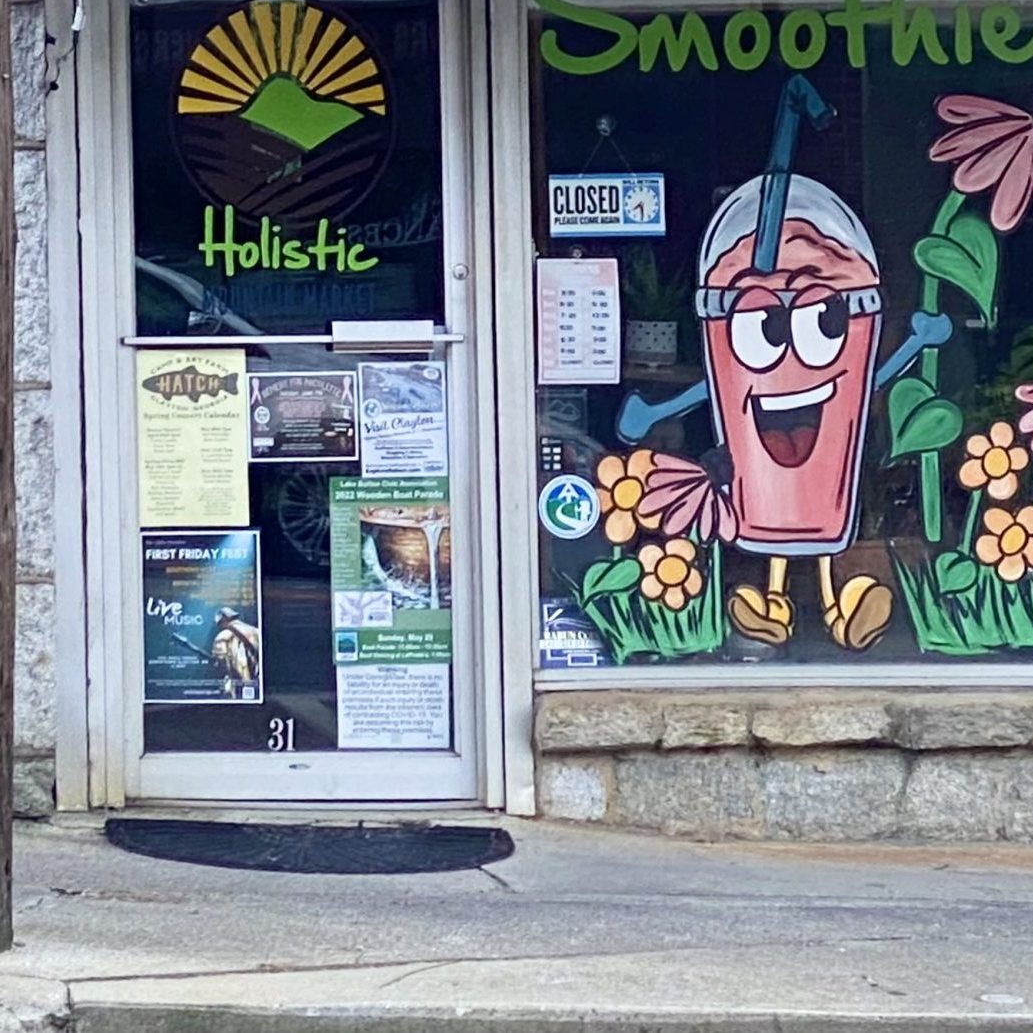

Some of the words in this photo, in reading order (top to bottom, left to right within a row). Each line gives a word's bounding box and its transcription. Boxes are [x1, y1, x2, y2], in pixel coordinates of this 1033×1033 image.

[553, 185, 619, 215] CLOSED
[554, 217, 578, 225] PLEASE
[580, 217, 599, 225] COME
[601, 216, 620, 224] AGAIN
[198, 204, 379, 277] Holistic
[159, 374, 219, 392] HATCH
[335, 491, 355, 500] 2022
[414, 489, 444, 498] Parade
[146, 549, 176, 560] FIRST
[179, 548, 219, 559] FRIDAY
[146, 597, 183, 616] Live
[164, 614, 203, 625] MUSIC
[268, 718, 296, 752] 31
